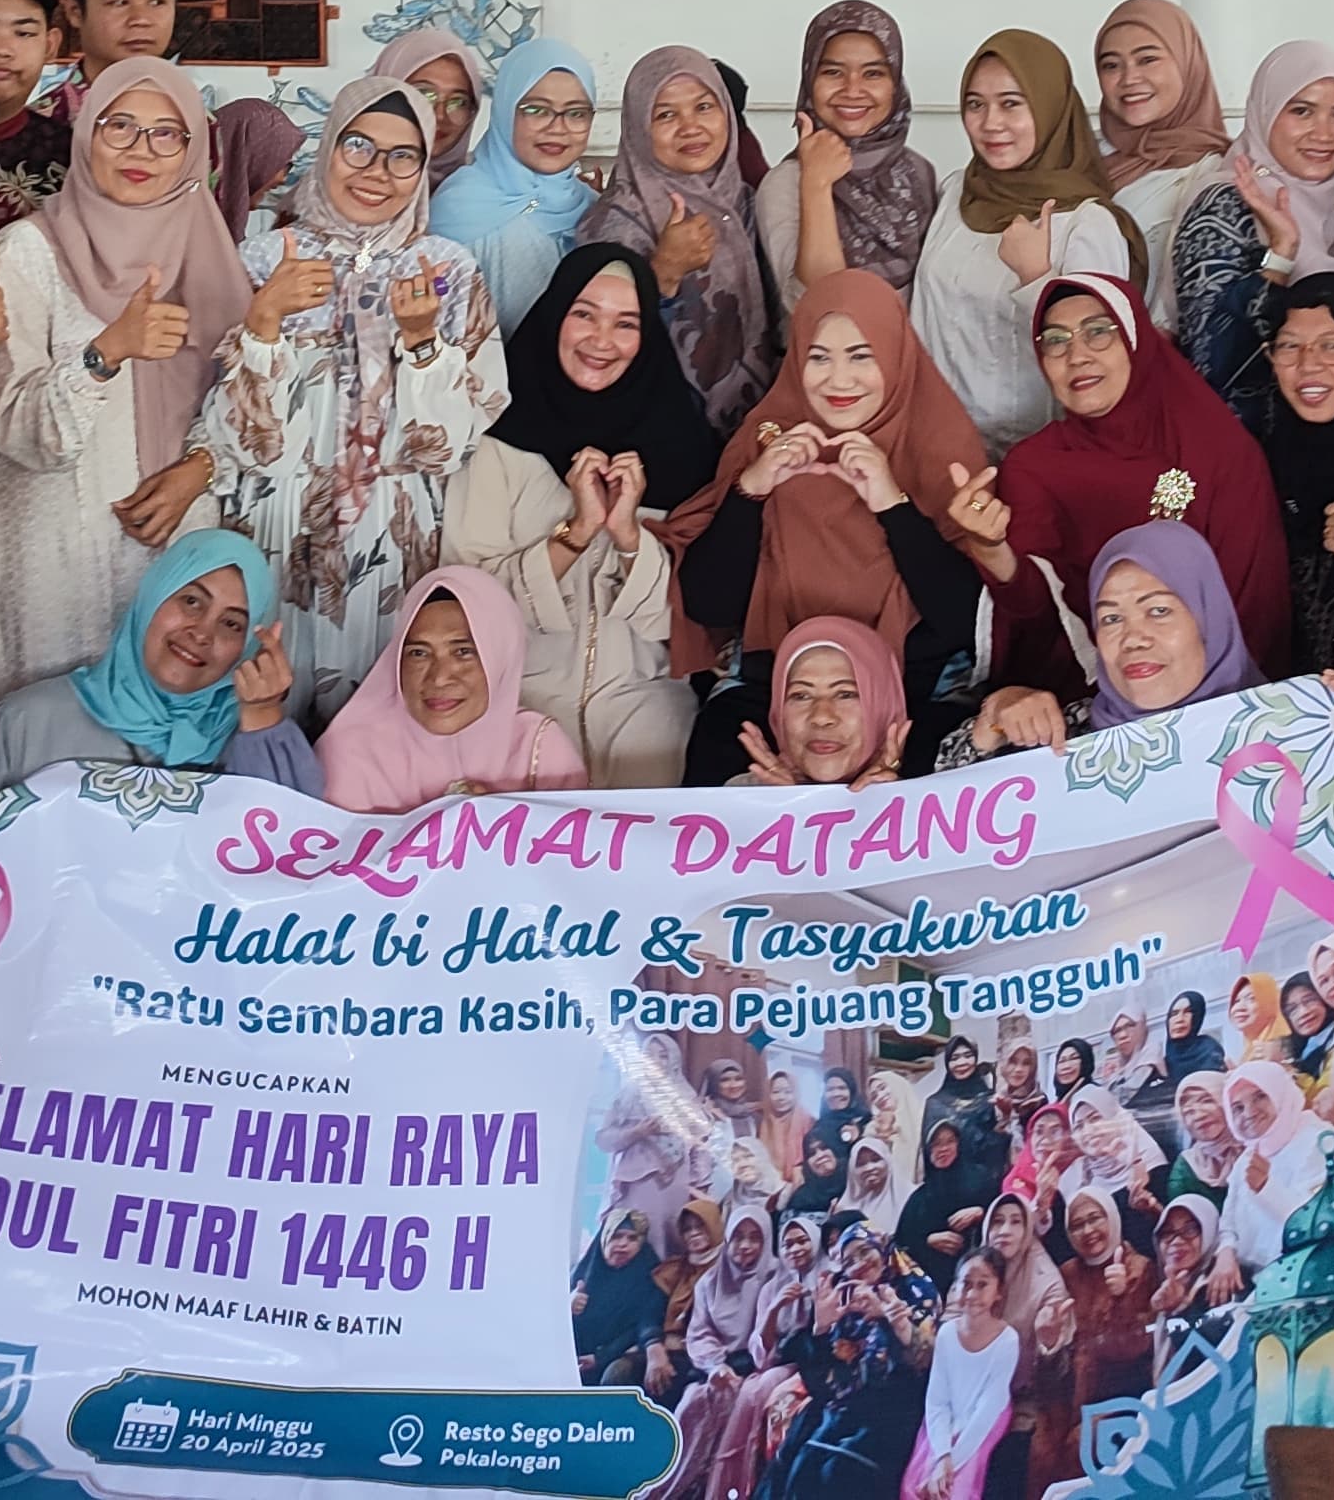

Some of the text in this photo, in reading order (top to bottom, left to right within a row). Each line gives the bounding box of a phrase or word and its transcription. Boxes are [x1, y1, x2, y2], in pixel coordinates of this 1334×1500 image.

[216, 775, 1036, 898] SELAMAT DATANG
[174, 891, 1085, 974] Halal bi Halal & Tasyakuran
[93, 937, 1162, 1037] "Ratu Sembara Kasih, Para Pejuang Tangguh"
[162, 1063, 351, 1095] MENGUCAPKAN
[227, 1109, 371, 1185] HARI
[389, 1112, 539, 1187] RAYA
[103, 1193, 258, 1280] FITRI
[279, 1212, 430, 1292] 1446
[450, 1215, 491, 1290] H
[77, 1282, 403, 1336] MOHON MAAF LAHIR & BATIN
[178, 1434, 325, 1459] 20 April 2025
[187, 1408, 313, 1438] Hari Minggu
[444, 1420, 635, 1449] Resto Sego Dalem
[439, 1448, 561, 1474] Pekalongan
